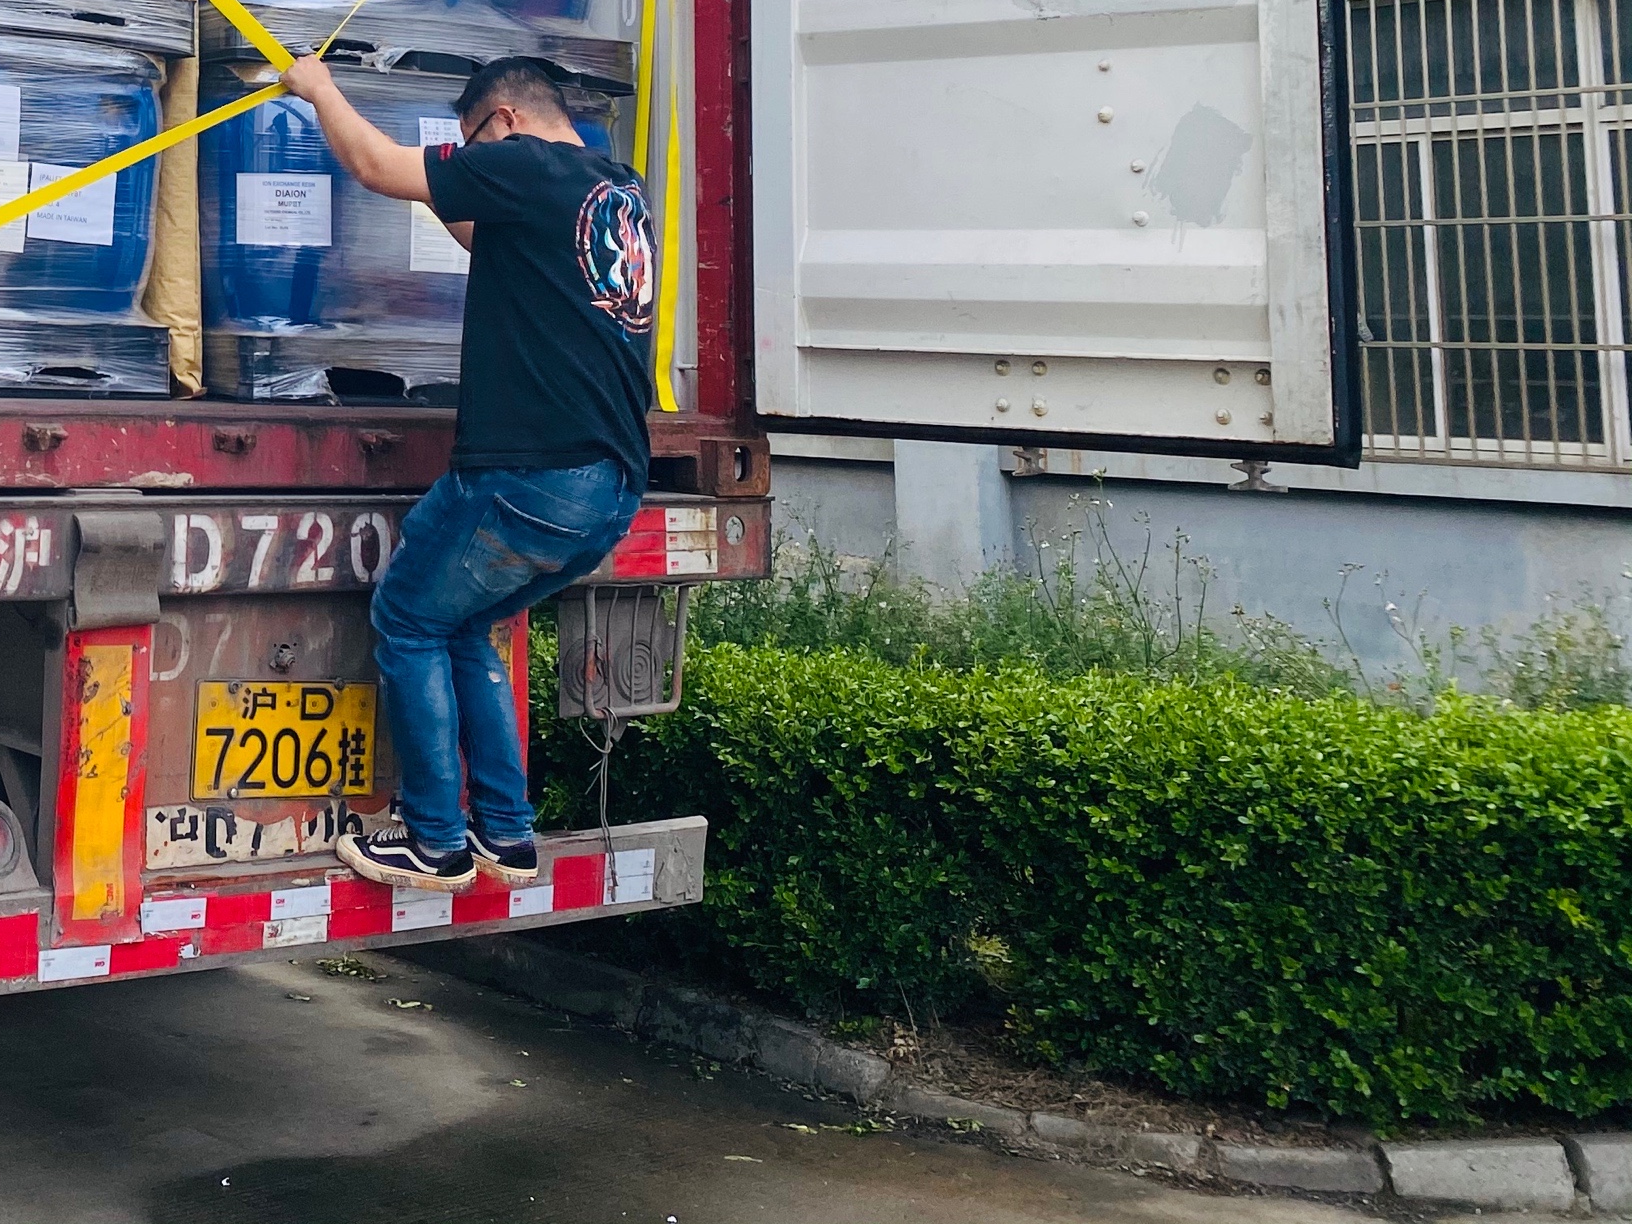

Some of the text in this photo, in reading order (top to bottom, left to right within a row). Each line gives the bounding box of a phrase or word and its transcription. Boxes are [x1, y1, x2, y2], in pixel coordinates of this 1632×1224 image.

[275, 189, 307, 198] DIAION
[36, 212, 54, 220] MADE
[63, 214, 88, 224] TAIWAN
[205, 727, 366, 791] 7206挂
